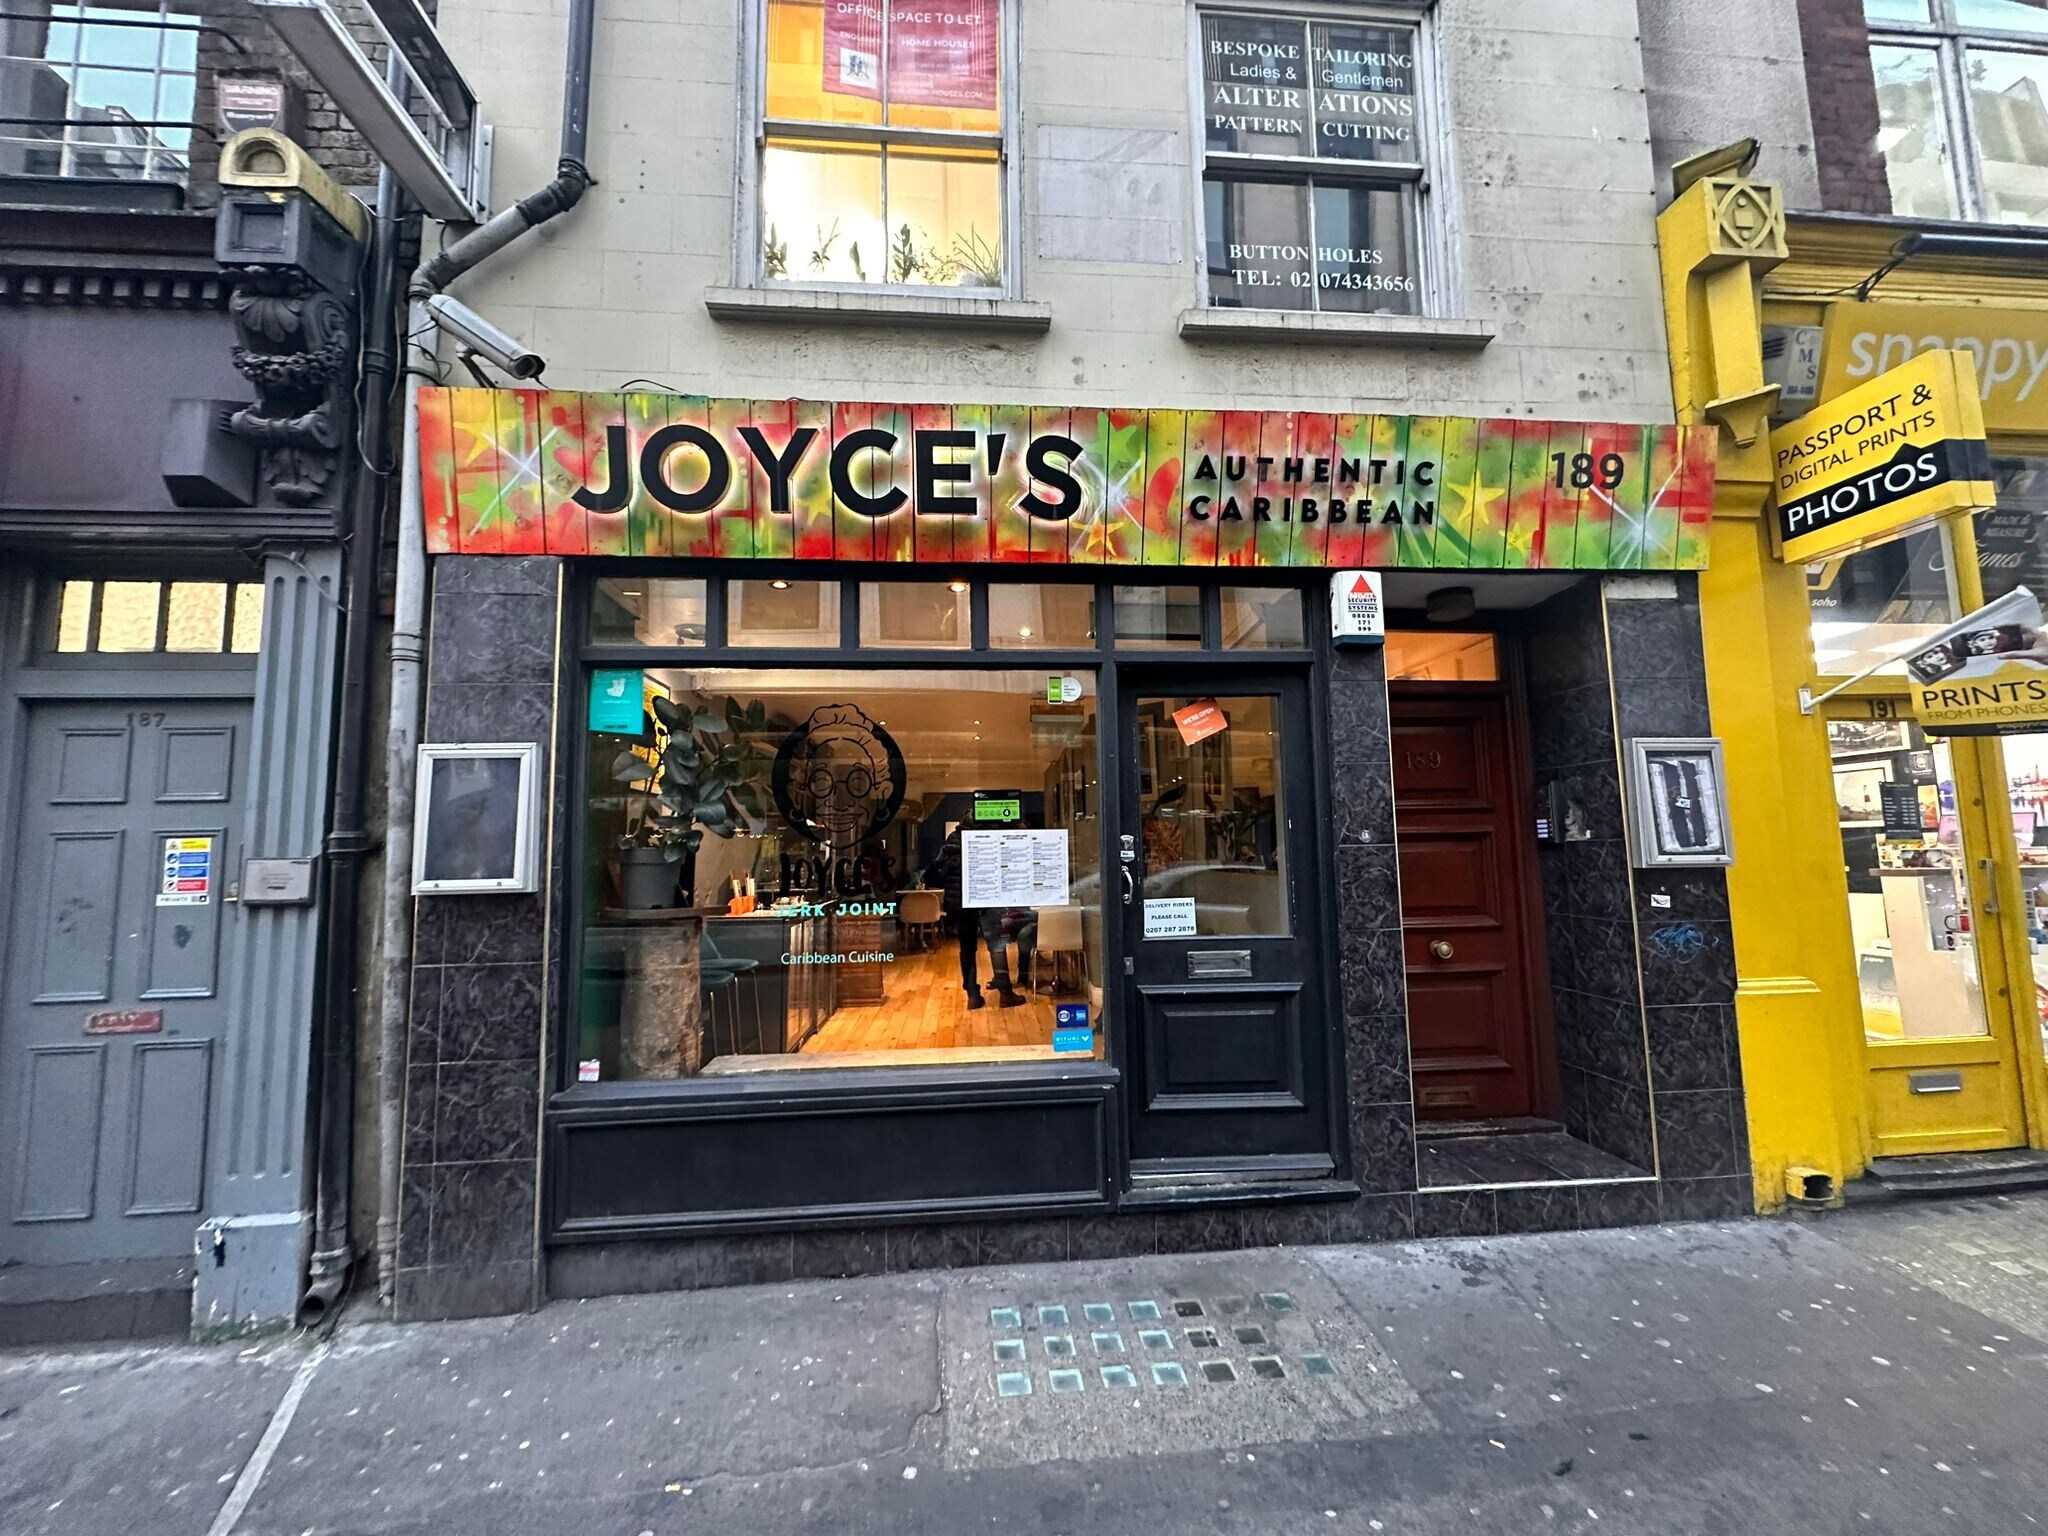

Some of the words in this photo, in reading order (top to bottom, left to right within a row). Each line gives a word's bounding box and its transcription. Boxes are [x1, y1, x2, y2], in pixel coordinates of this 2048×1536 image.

[837, 3, 883, 21] OFFICE
[889, 12, 931, 24] SPACE
[935, 13, 954, 24] TO
[957, 14, 981, 25] LET
[901, 39, 931, 47] HOME
[934, 40, 976, 49] HOUSES
[1211, 40, 1299, 59] BESPOKE
[1312, 47, 1413, 68] TAILORING
[1230, 63, 1281, 79] Ladies
[1286, 66, 1297, 80] &
[1322, 69, 1404, 88] Gentlemen
[1214, 86, 1301, 108] ALTER
[1318, 93, 1413, 117] ATIONS
[1215, 114, 1303, 134] PATTERN
[1322, 122, 1410, 141] CUTTING
[1229, 244, 1309, 261] BUTTON
[1318, 247, 1383, 264] HOLES
[1232, 269, 1281, 287] TEL:
[1777, 393, 1902, 468] PASSPORT
[1911, 383, 1933, 406] &
[1780, 448, 1854, 490] DIGITAL
[1858, 410, 1935, 456] PRINTS
[571, 424, 1084, 521] JOYCE'S
[1194, 454, 1435, 487] AUTHENTIC
[1551, 452, 1625, 490] 189
[1787, 453, 1938, 532] PHOTOS
[1190, 495, 1435, 525] CARIBBEAN
[1811, 596, 1837, 607] soho
[1922, 680, 2047, 709] PRINTS
[126, 712, 166, 727] 187
[1868, 700, 1897, 719] 191
[1928, 708, 1971, 721] FROM
[1976, 703, 2048, 718] PHONES
[776, 904, 826, 917] JERK
[836, 902, 897, 917] JOINT
[780, 951, 845, 965] Caribbean
[848, 951, 894, 963] Cuisine
